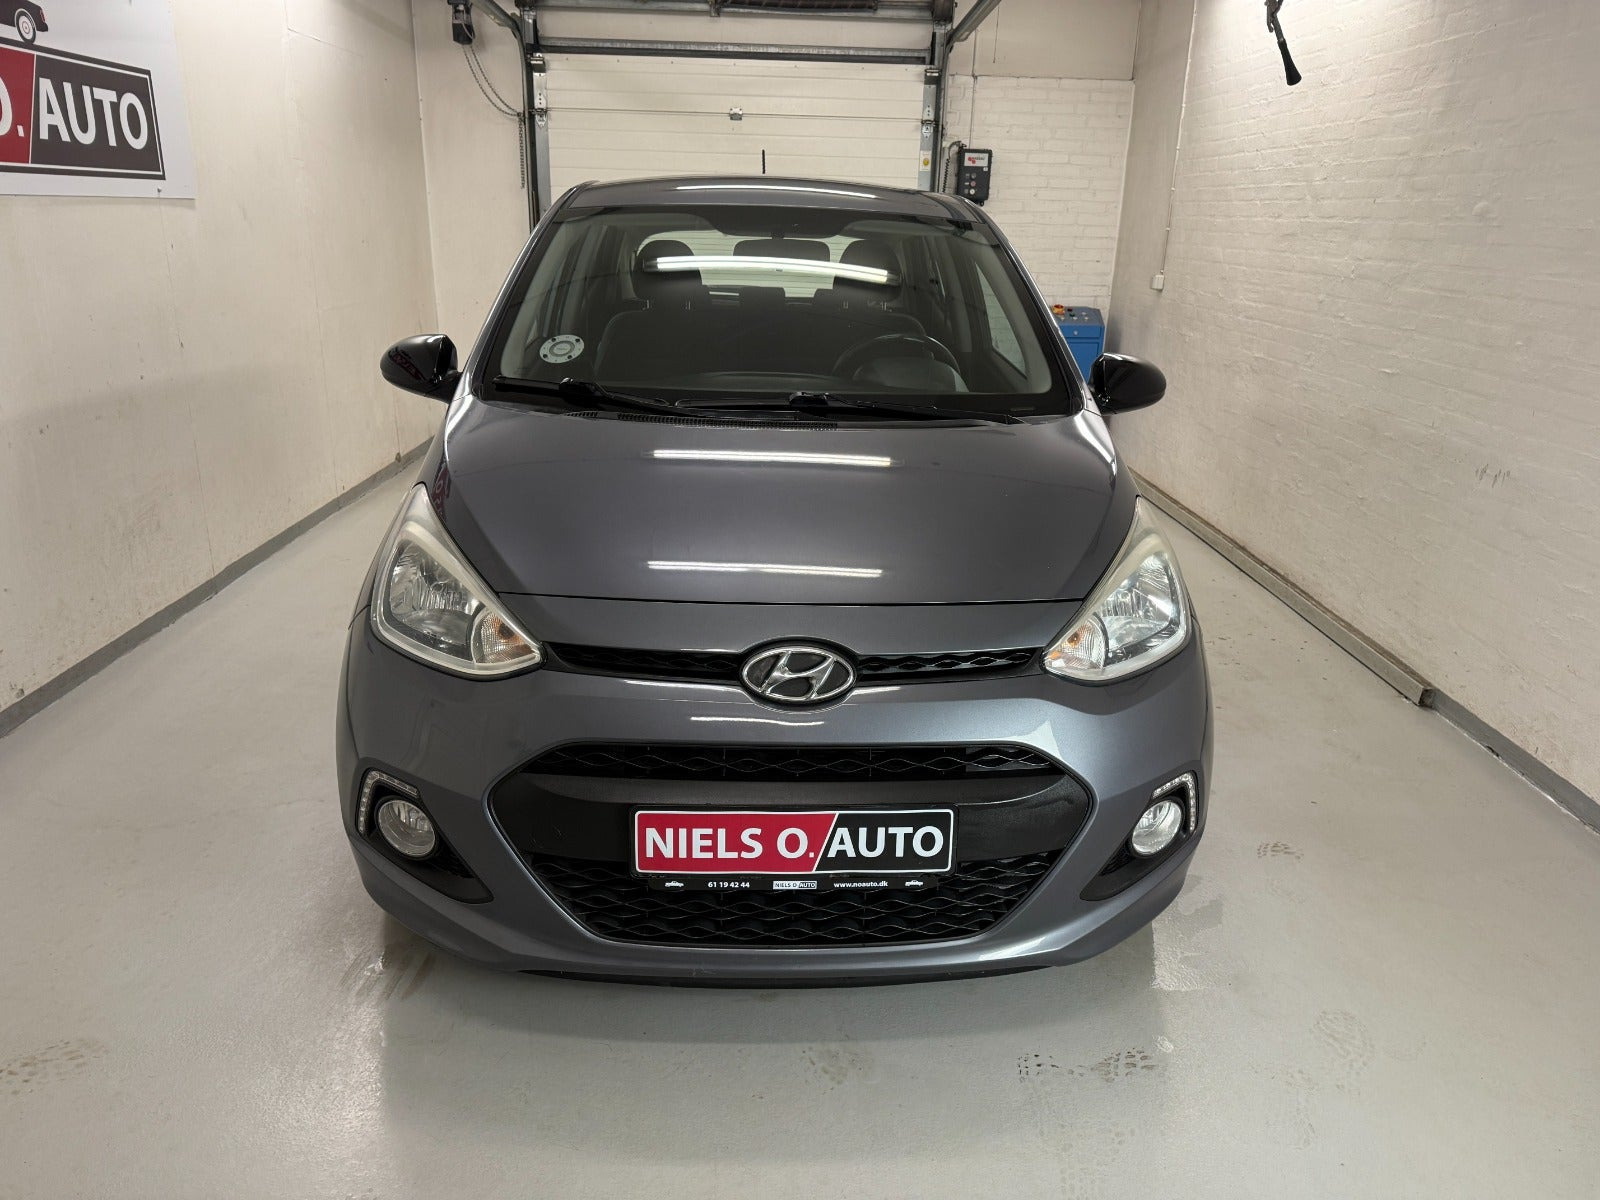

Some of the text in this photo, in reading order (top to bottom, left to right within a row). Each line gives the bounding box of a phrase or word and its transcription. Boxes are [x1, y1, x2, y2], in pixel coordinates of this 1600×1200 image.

[39, 77, 148, 149] AUTO
[645, 825, 945, 859] NIELS O. AUTO
[833, 880, 888, 888] www.noauto.dk
